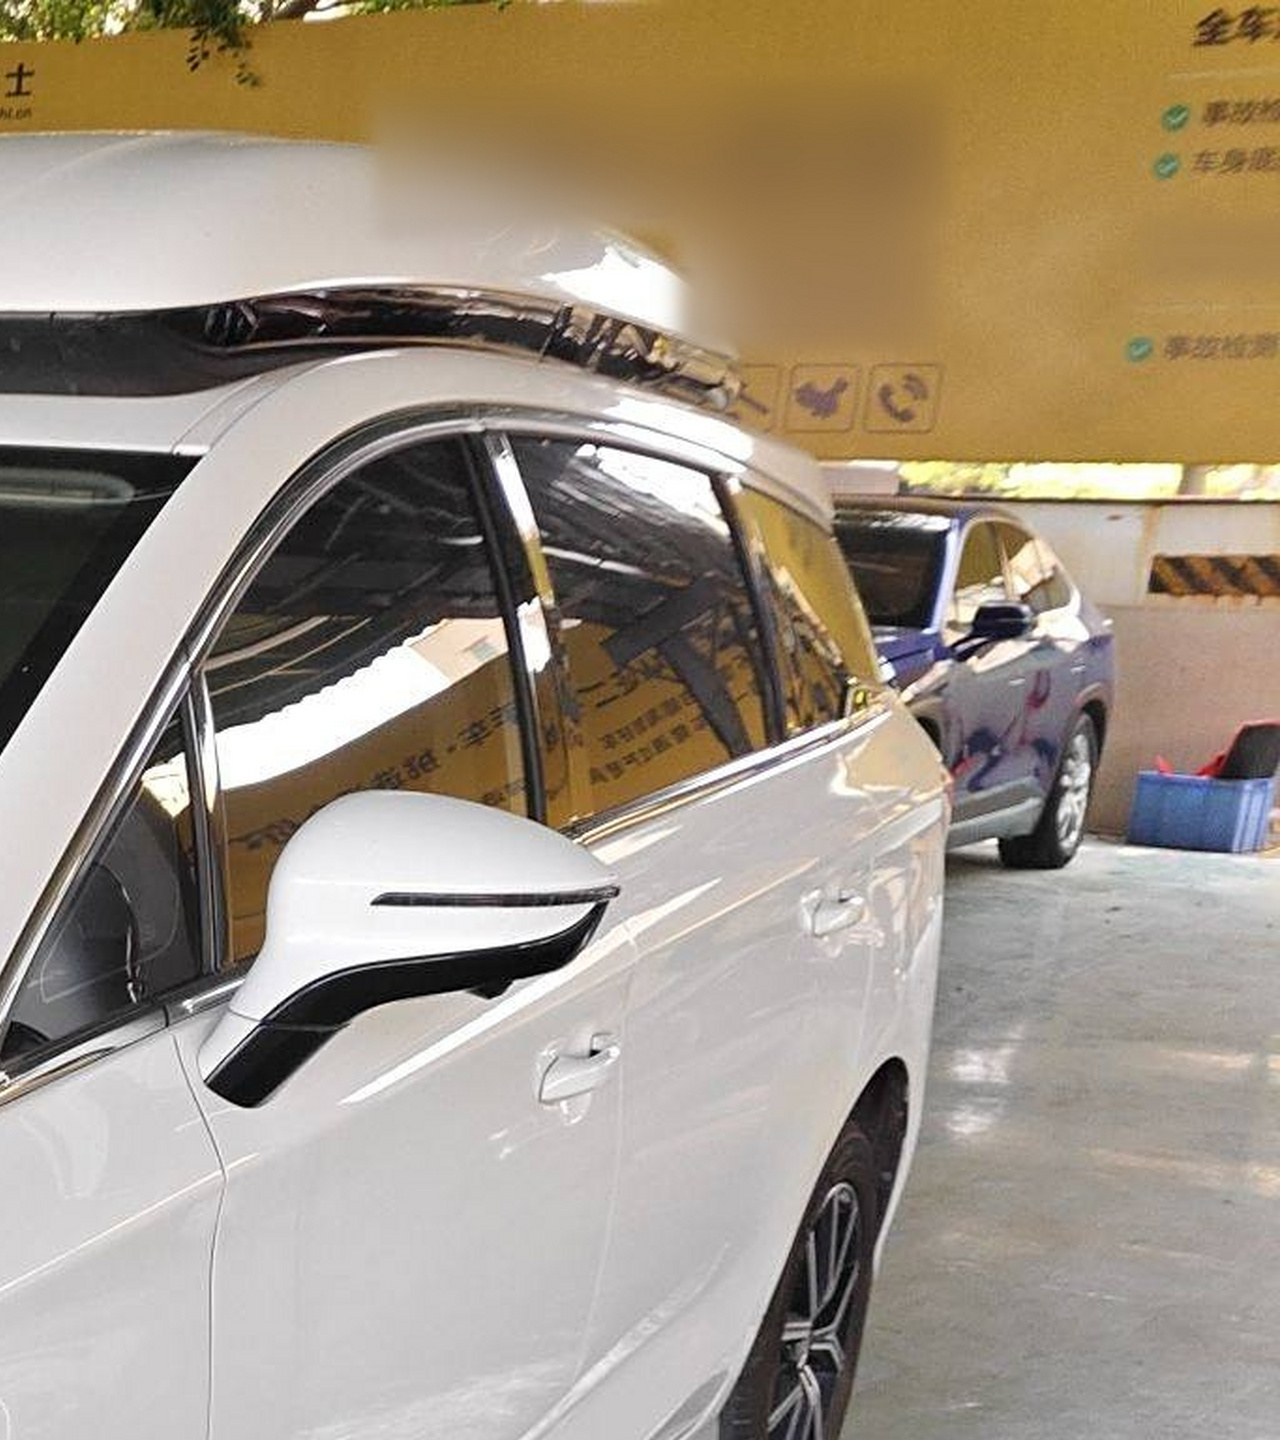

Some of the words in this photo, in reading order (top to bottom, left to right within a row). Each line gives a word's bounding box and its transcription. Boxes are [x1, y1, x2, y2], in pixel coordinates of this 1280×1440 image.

[1192, 5, 1280, 47] 全车
[1192, 147, 1280, 175] 车身底
